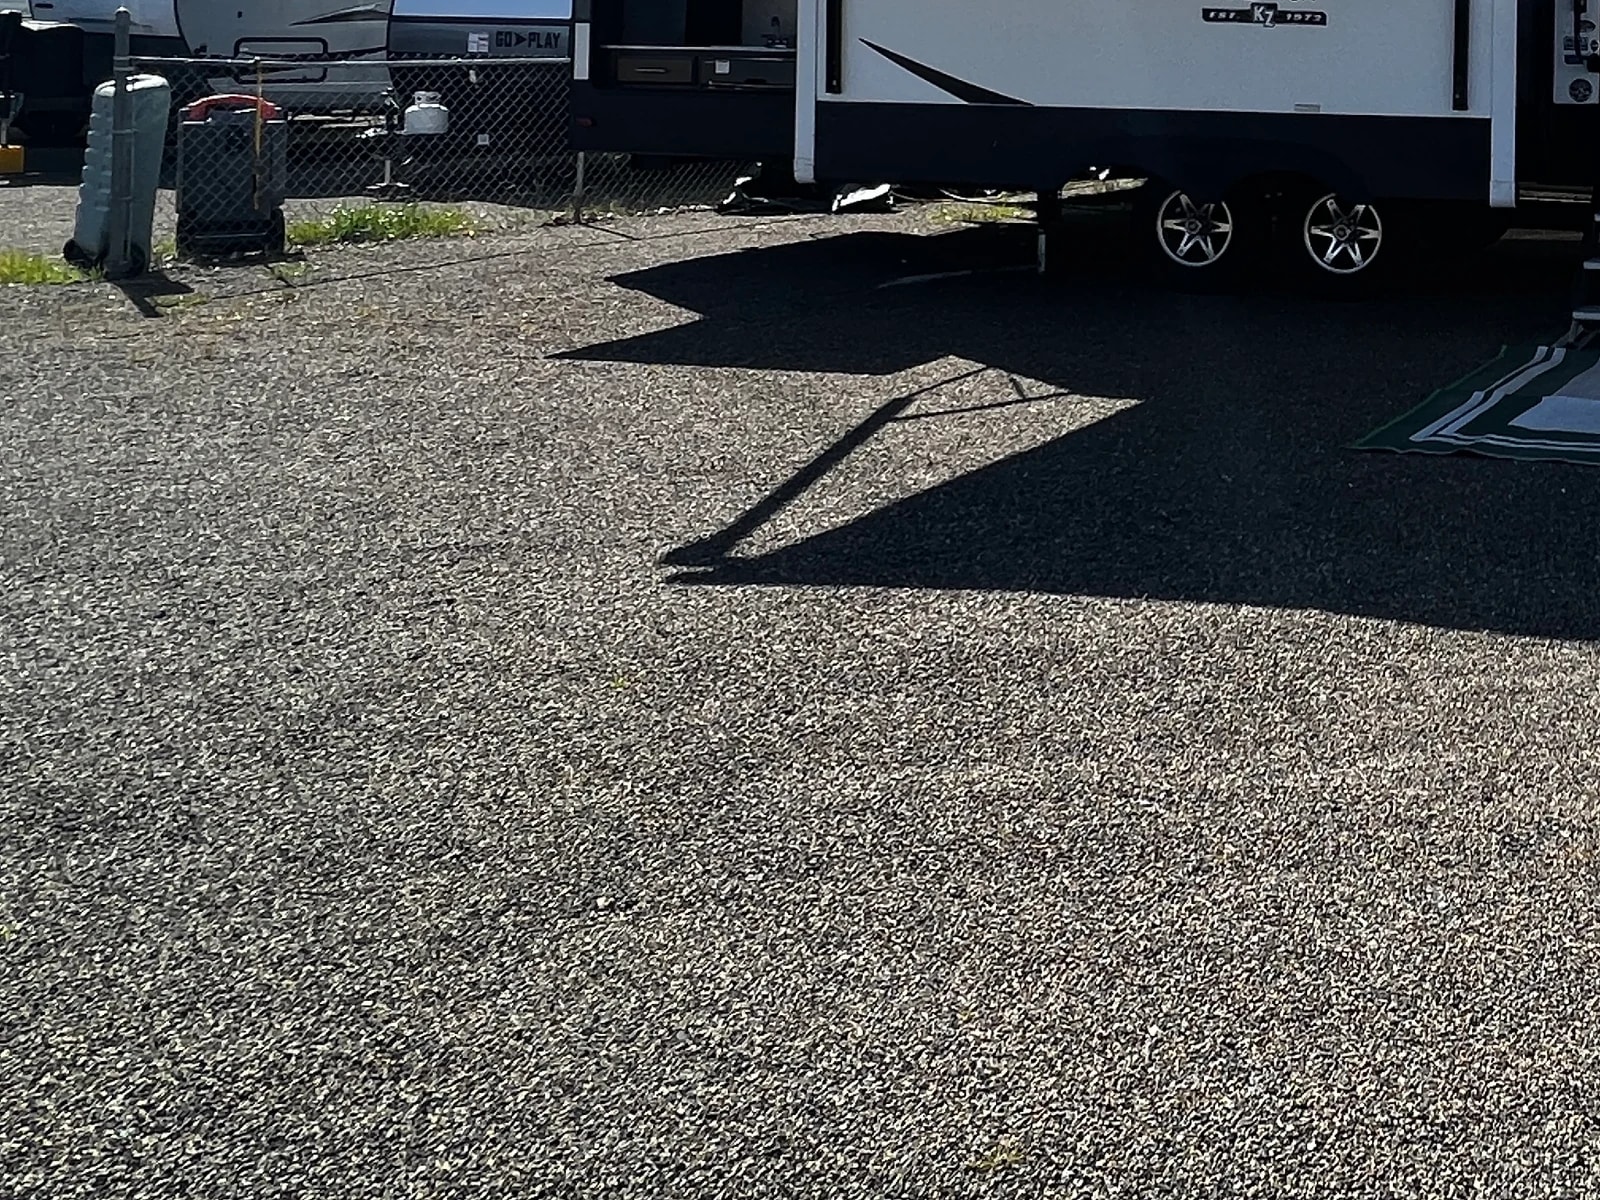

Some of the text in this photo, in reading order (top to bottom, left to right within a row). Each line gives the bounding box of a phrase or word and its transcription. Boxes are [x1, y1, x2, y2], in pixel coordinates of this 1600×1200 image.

[1253, 4, 1275, 27] KZ
[495, 30, 561, 49] GO PLAY
